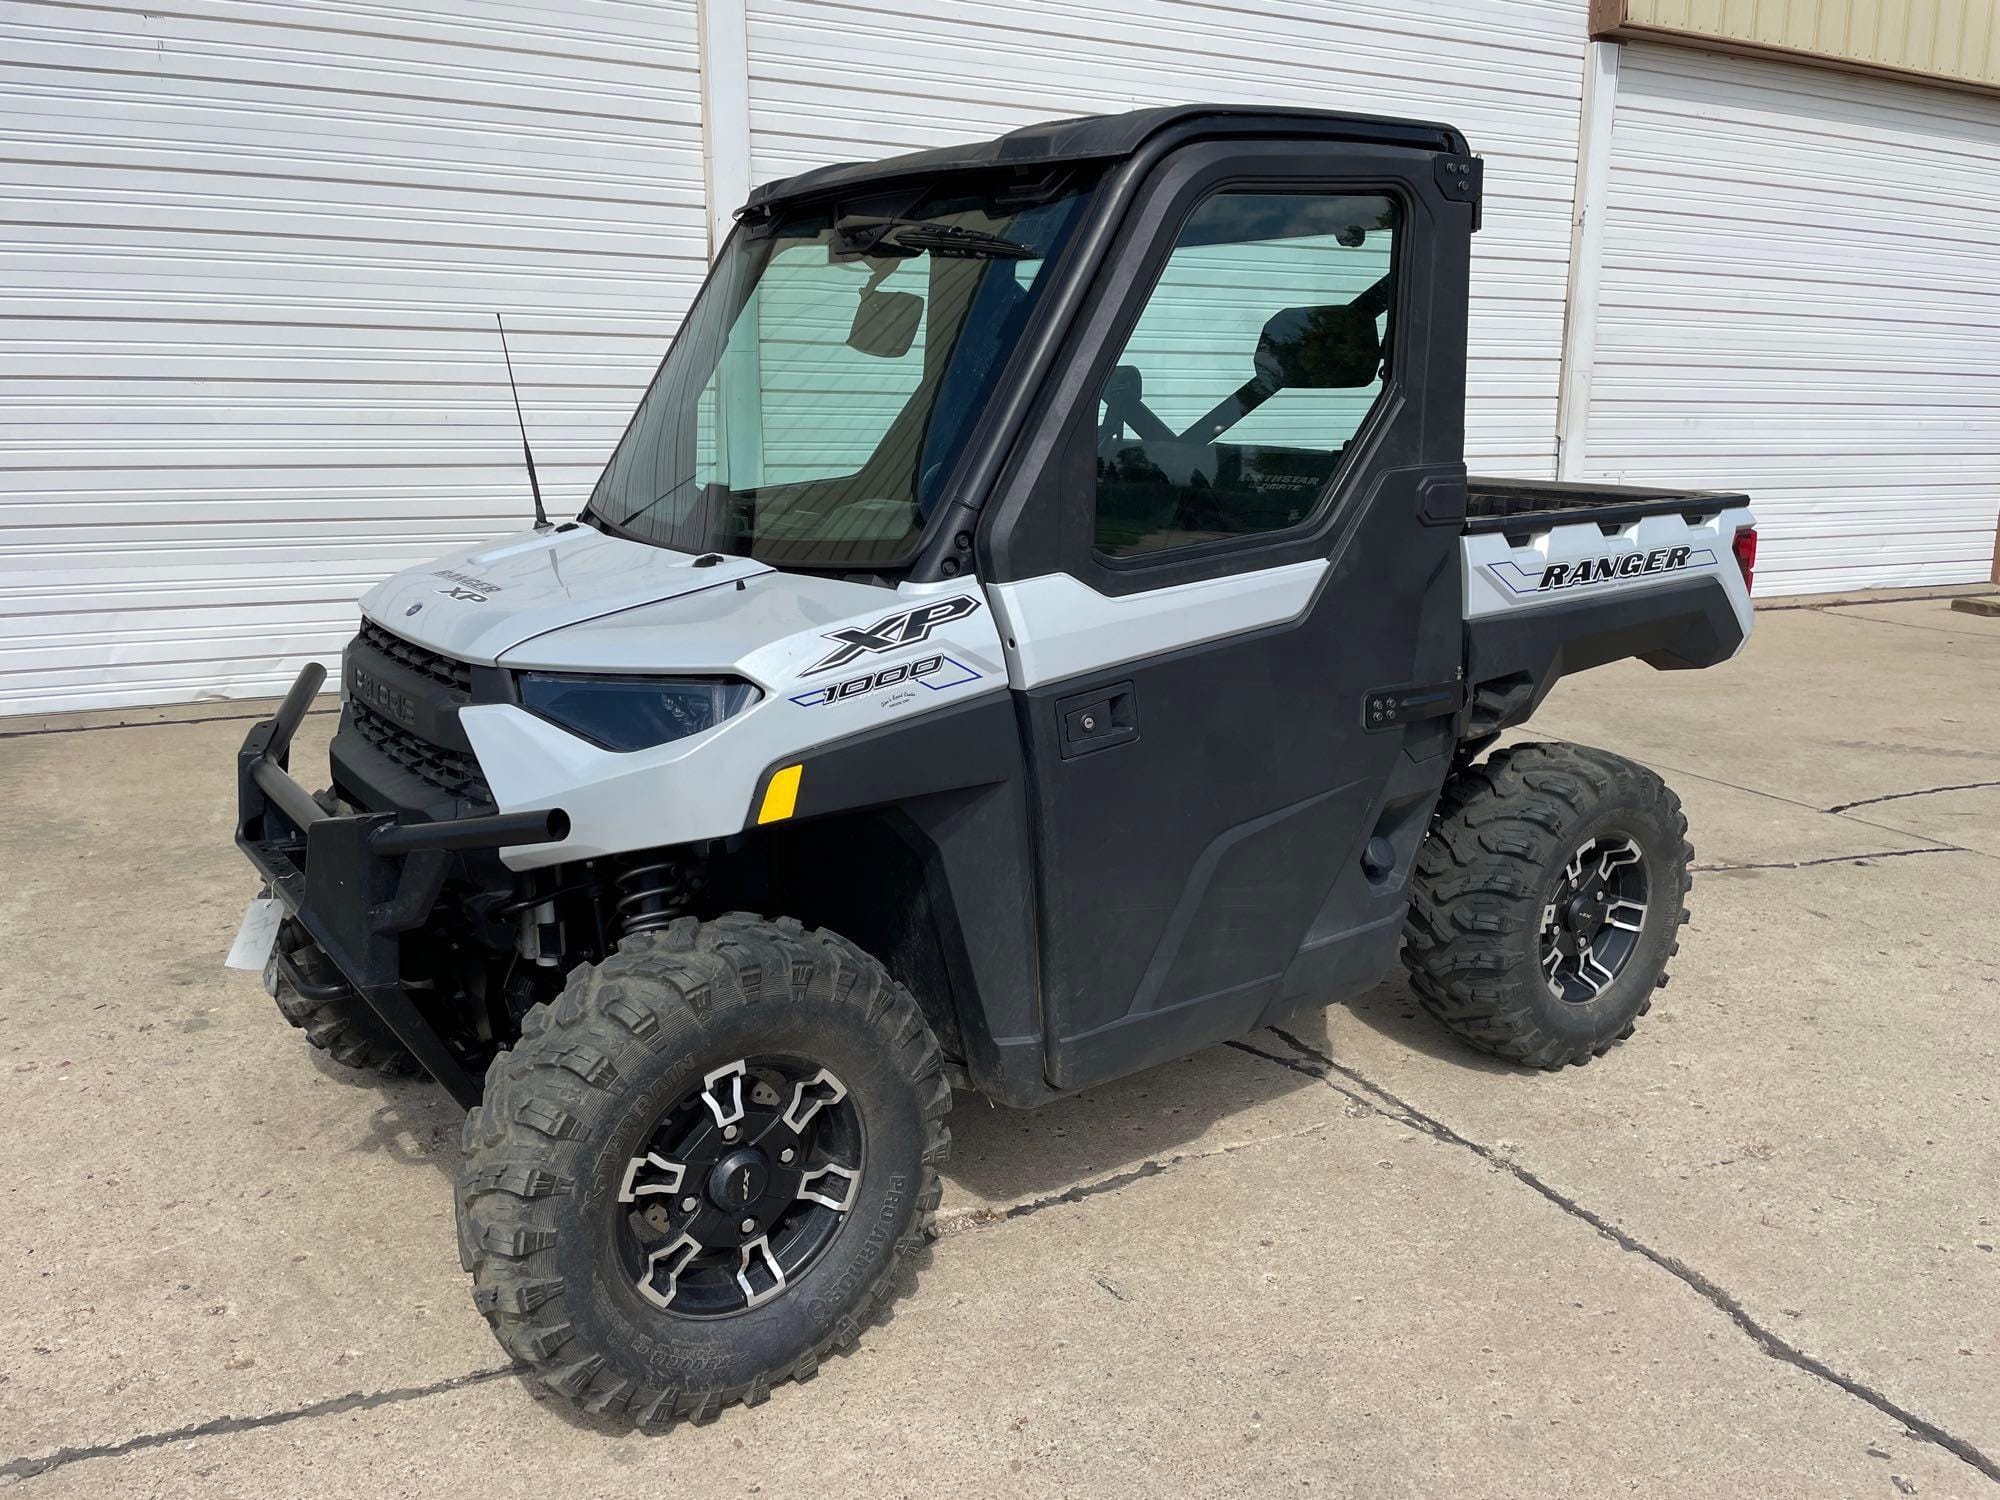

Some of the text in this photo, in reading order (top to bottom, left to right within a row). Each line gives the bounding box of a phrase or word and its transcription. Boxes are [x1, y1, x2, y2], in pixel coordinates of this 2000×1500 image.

[1537, 545, 1692, 592] RANGER
[434, 586, 489, 603] XP
[796, 593, 982, 678] XP
[822, 652, 945, 706] 1000
[579, 1052, 697, 1216] X-TERRAIN
[880, 1175, 906, 1223] PRO
